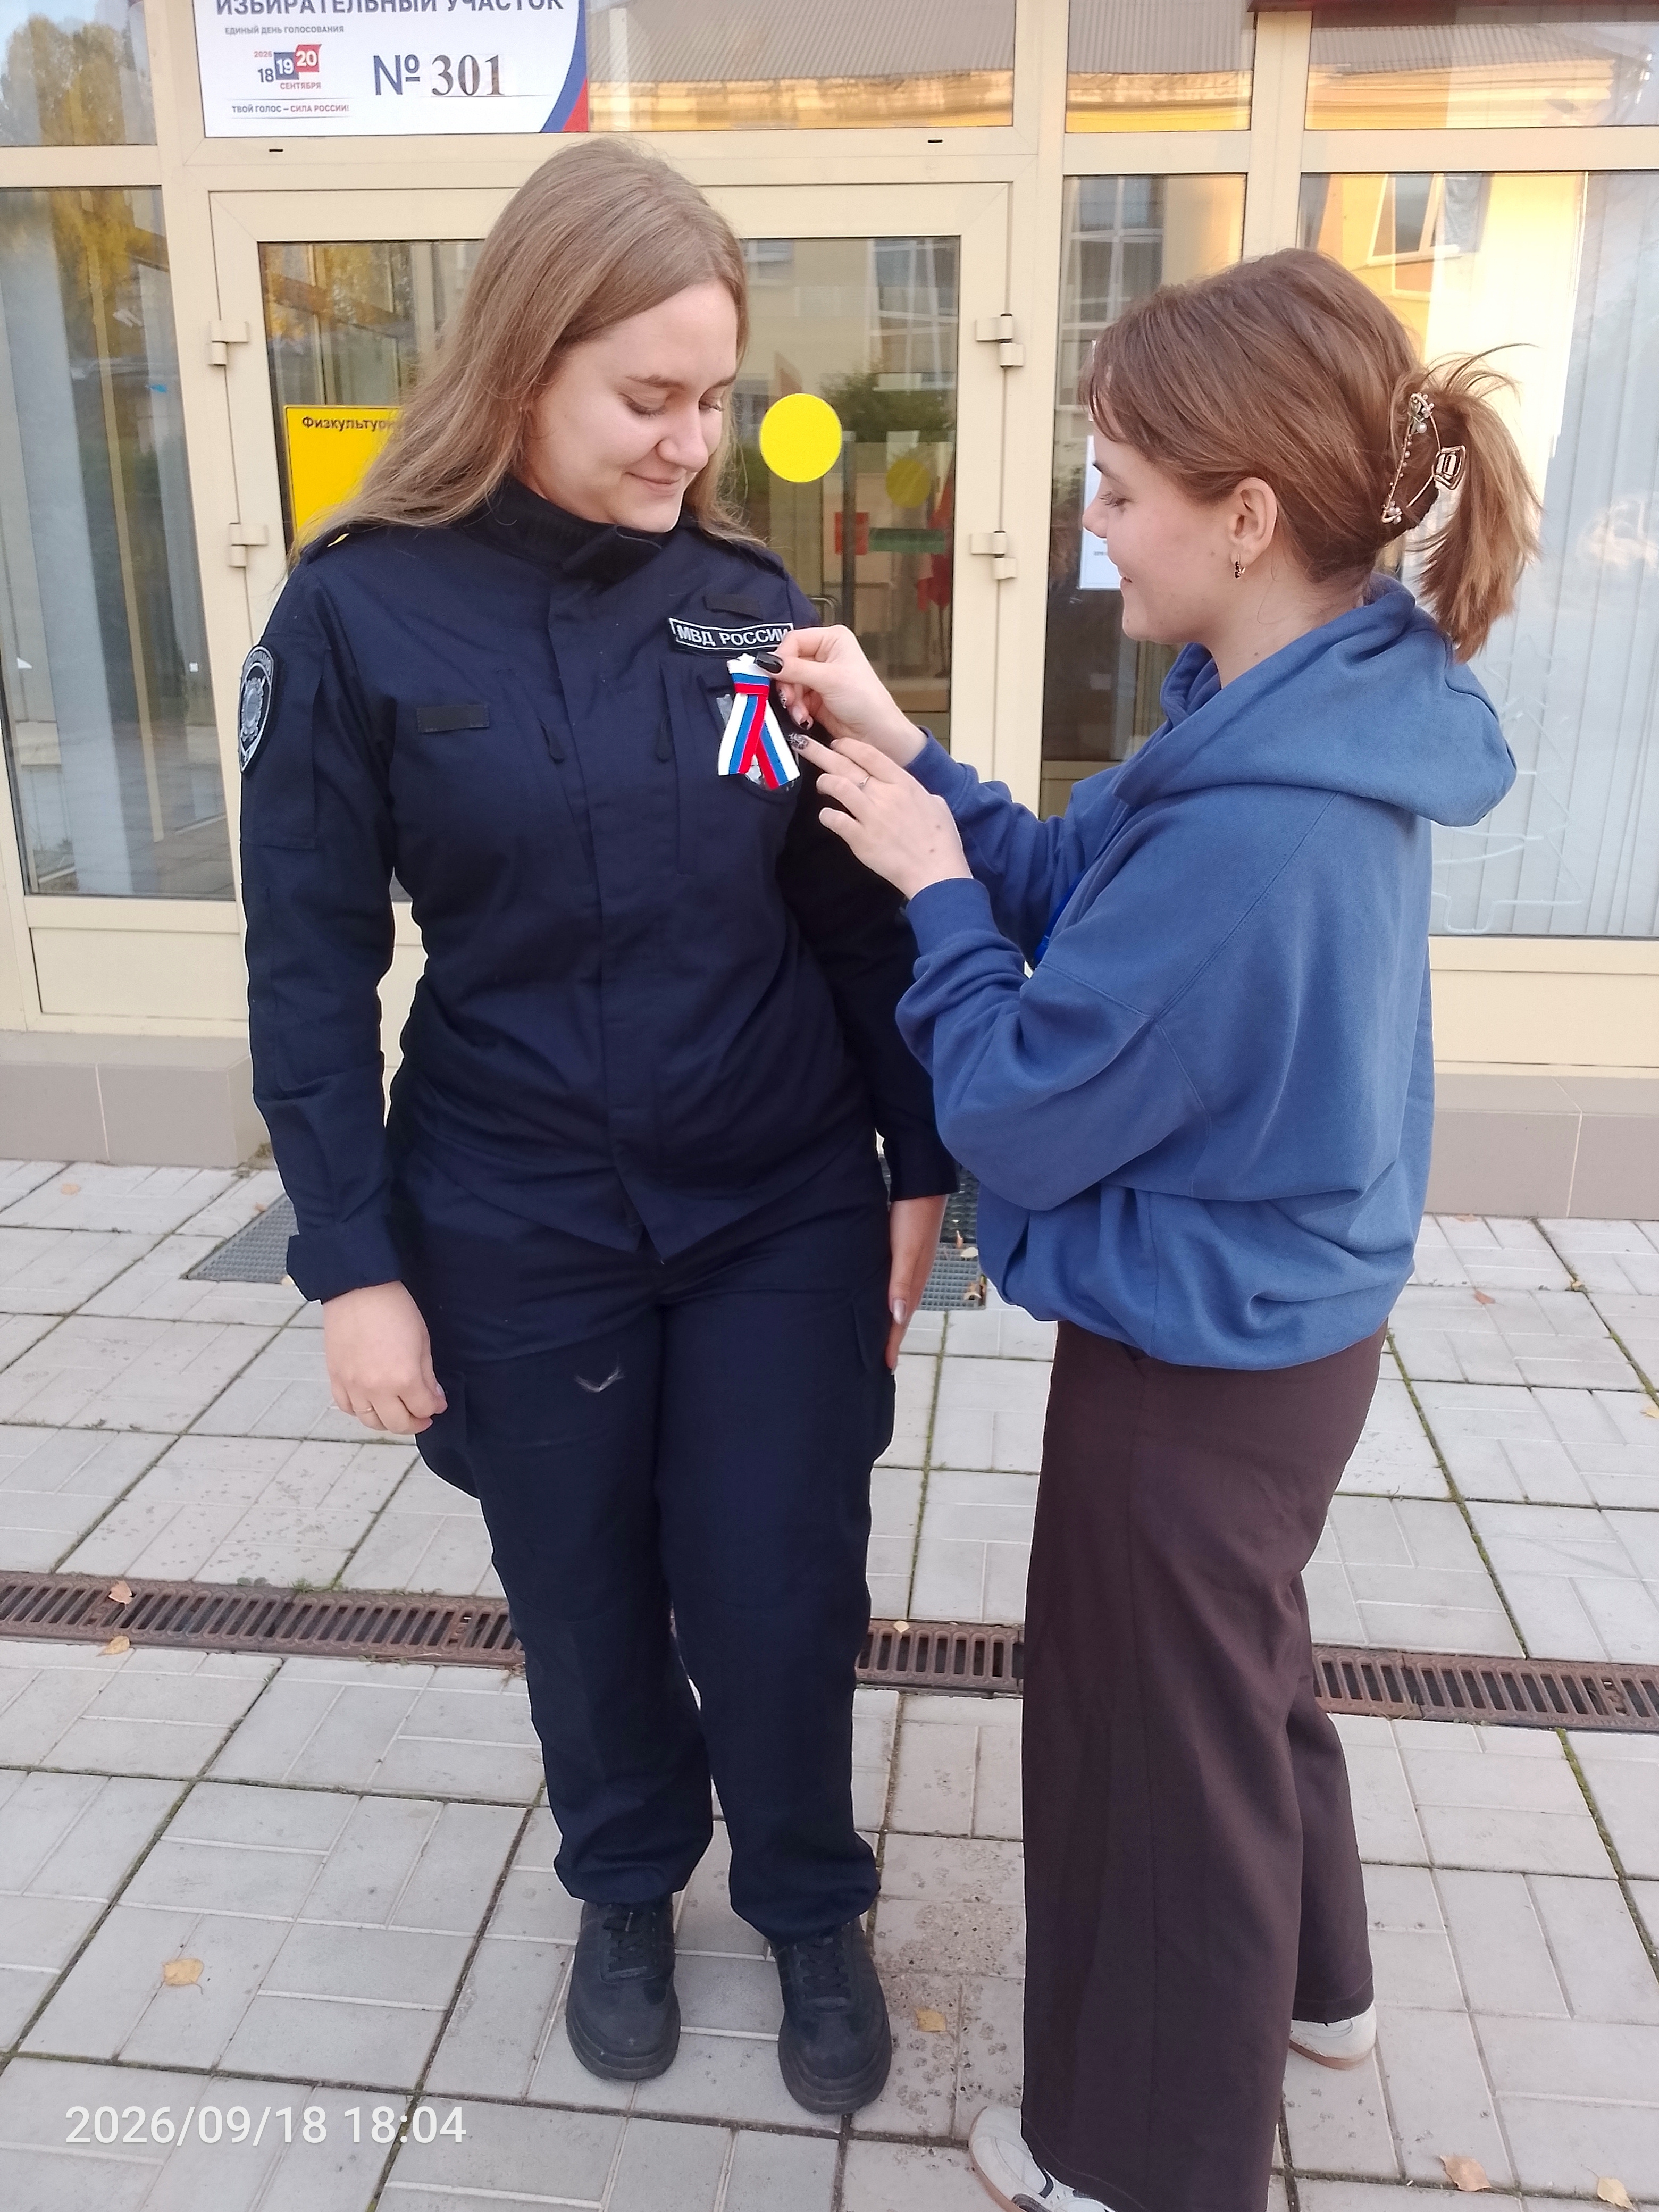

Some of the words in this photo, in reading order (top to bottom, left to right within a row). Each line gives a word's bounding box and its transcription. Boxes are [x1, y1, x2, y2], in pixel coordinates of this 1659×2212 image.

[225, 26, 259, 35] ЕДИНЫЙ
[257, 68, 274, 83] 18
[276, 58, 294, 75] 19
[296, 50, 317, 67] 20
[373, 54, 421, 95] №
[432, 54, 505, 96] 301
[232, 104, 254, 113] ТВОЙ
[303, 416, 393, 432] Физкультур
[676, 624, 716, 647] МВД
